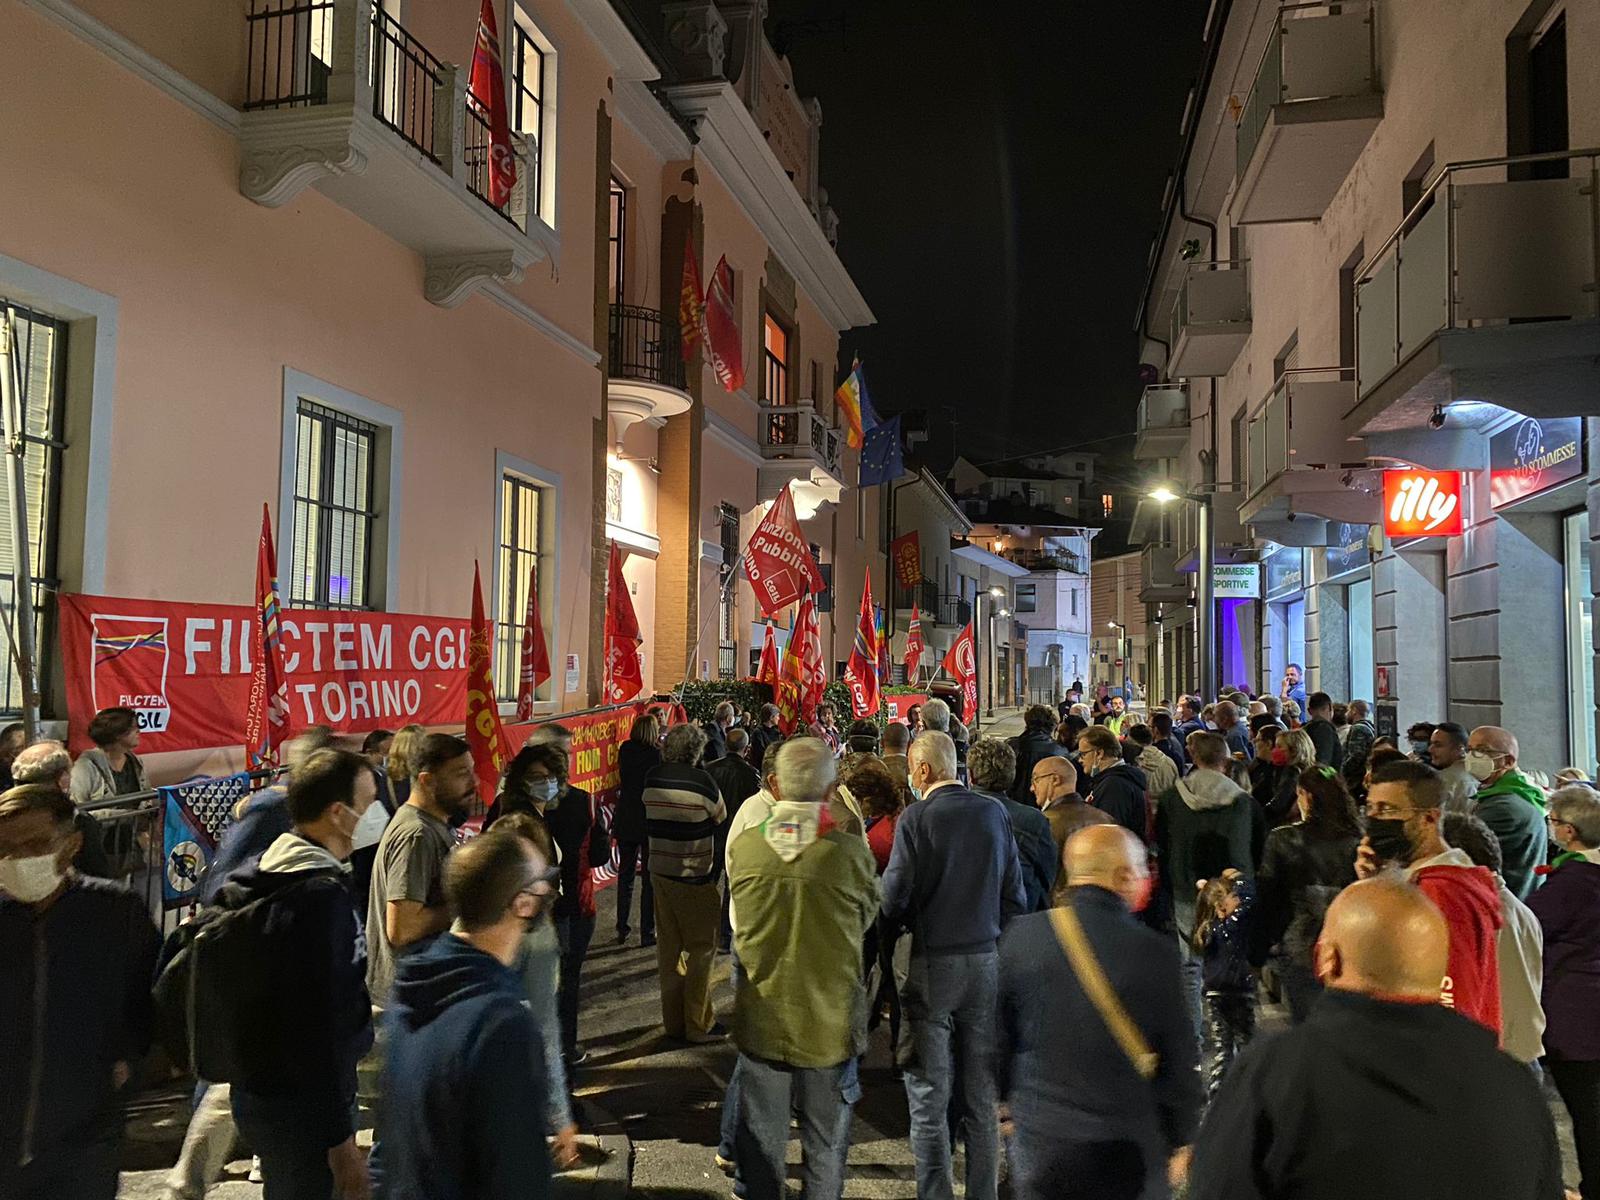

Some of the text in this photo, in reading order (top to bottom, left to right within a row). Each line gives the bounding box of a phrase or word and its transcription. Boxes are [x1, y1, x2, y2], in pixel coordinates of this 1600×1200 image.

[1528, 441, 1577, 474] SCOMMESSE
[1390, 477, 1457, 531] illy
[765, 579, 780, 602] CGIL
[185, 618, 392, 674] FILCTEM
[408, 625, 466, 671] CGI
[119, 694, 167, 706] FILCTEM
[295, 679, 421, 724] TORINO
[853, 684, 869, 717] CGIL
[136, 711, 163, 729] GIL
[576, 748, 601, 775] FIOM
